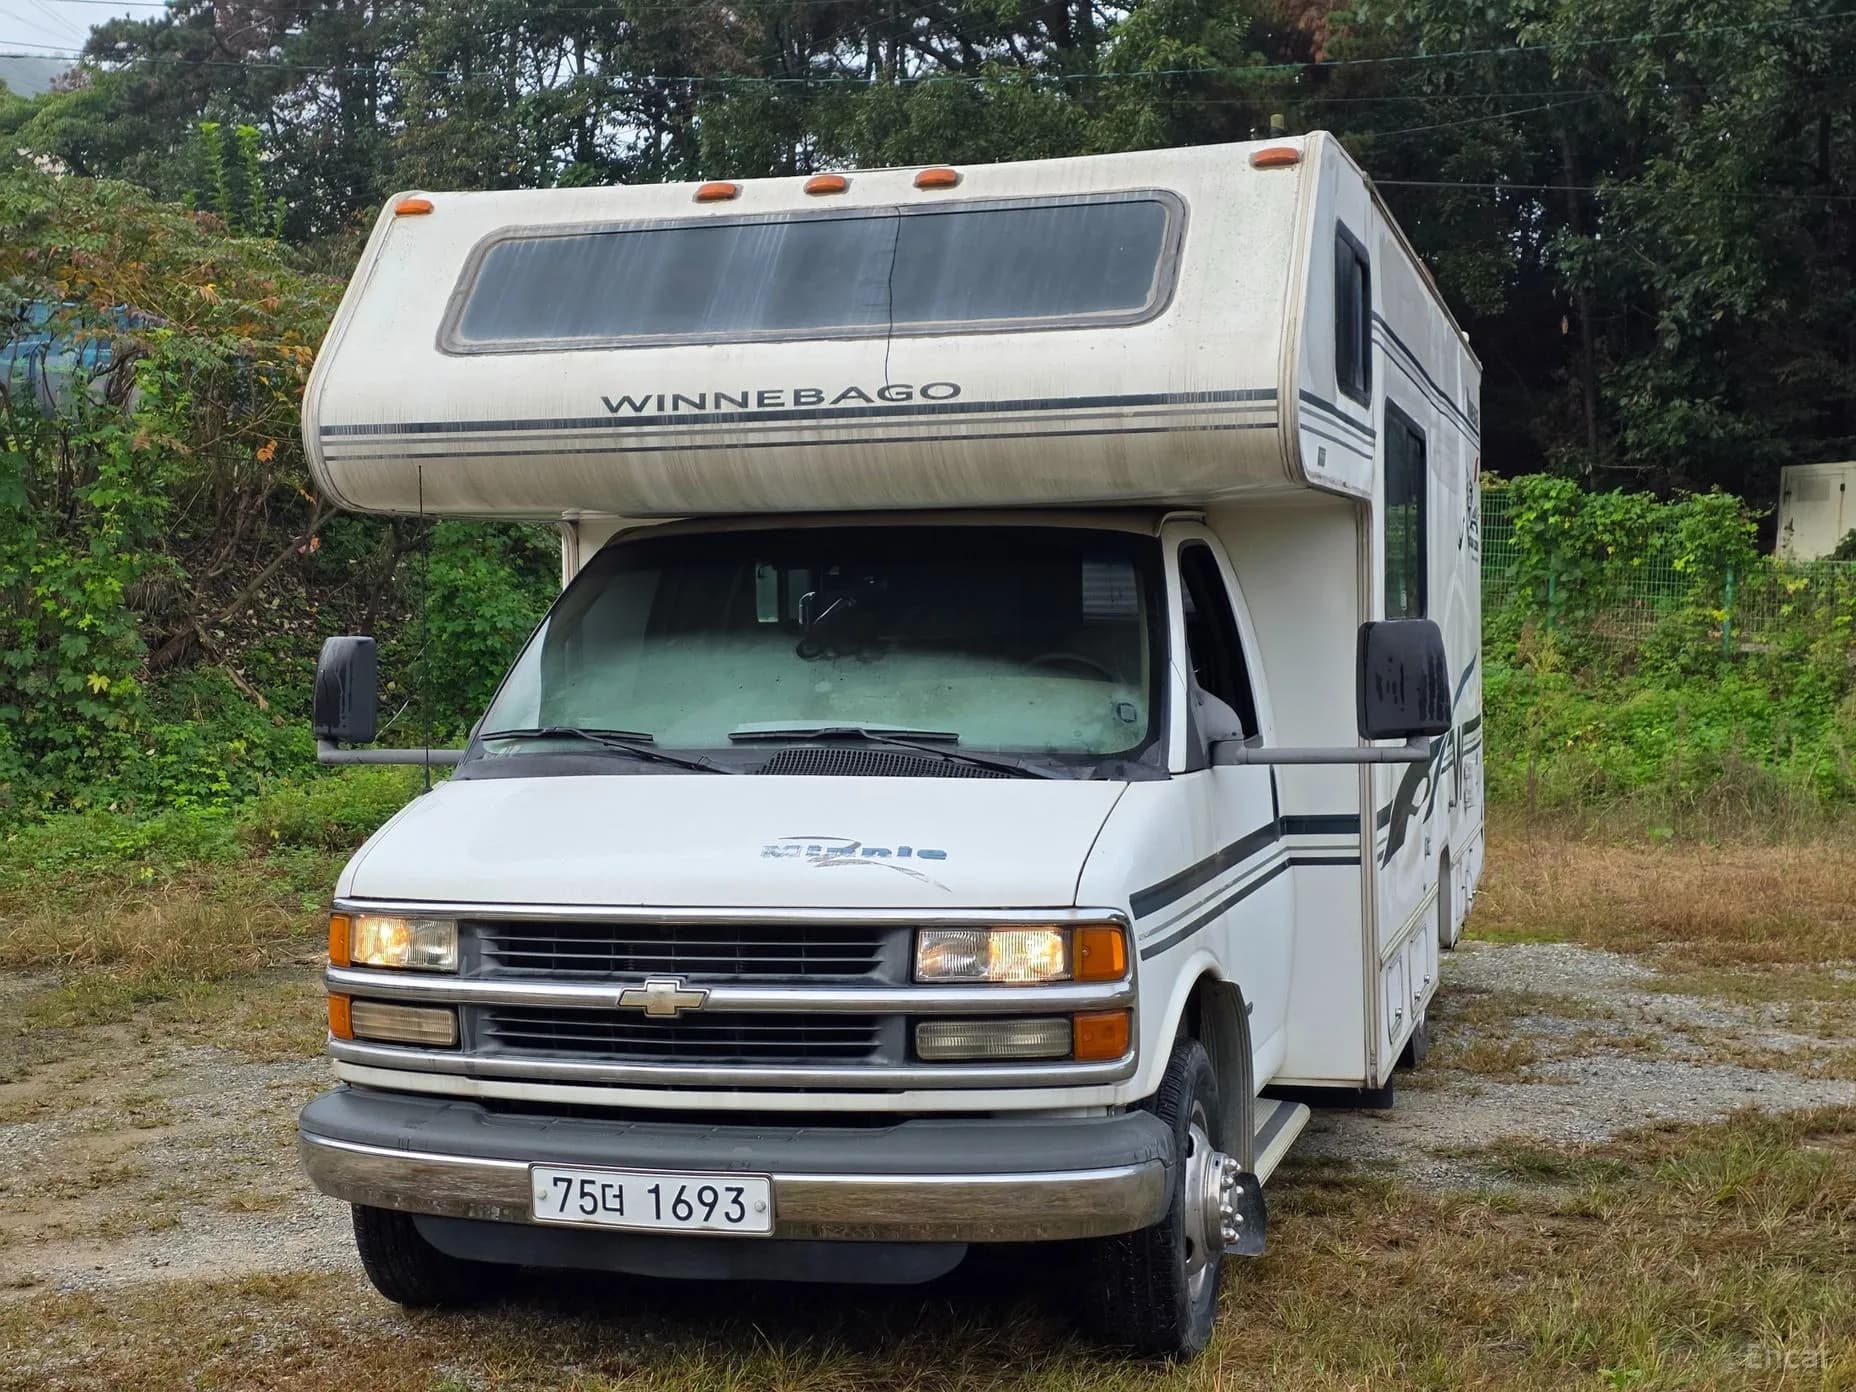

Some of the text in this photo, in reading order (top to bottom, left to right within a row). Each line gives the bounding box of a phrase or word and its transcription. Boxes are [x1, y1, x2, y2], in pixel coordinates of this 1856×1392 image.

[600, 382, 962, 414] WINNEBAGO
[552, 1176, 746, 1224] 75더 1693
